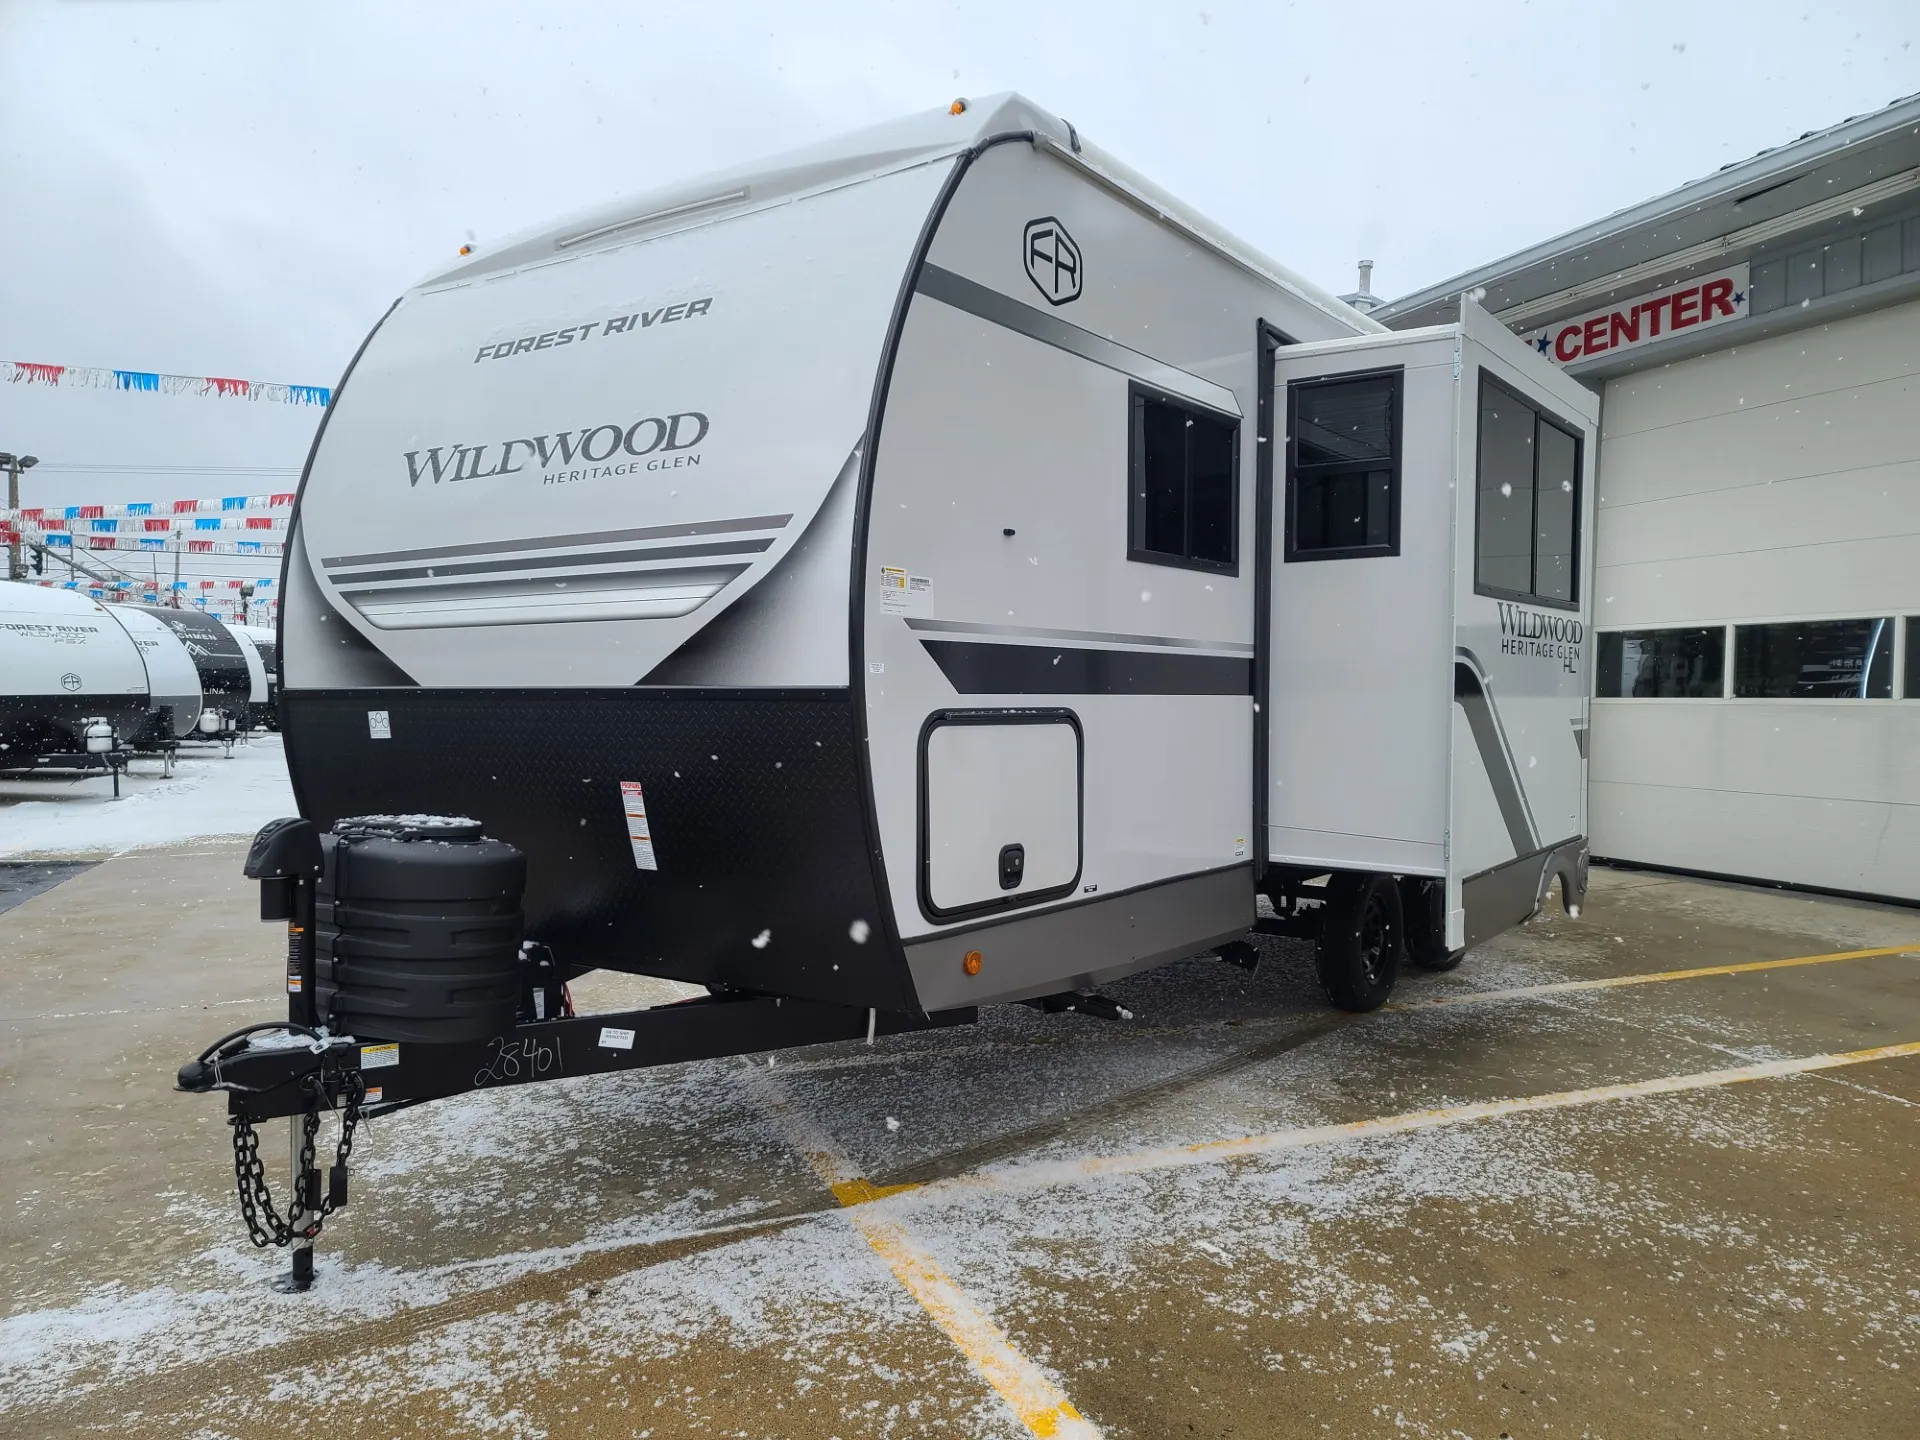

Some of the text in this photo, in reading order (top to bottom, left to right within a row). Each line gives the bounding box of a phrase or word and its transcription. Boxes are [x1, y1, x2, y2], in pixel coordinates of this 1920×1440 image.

[474, 297, 713, 364] FOREST RIVER
[1555, 277, 1736, 362] CENTER
[403, 411, 710, 488] WILDWOOD
[543, 454, 702, 485] HERITAGE GLEN
[0, 623, 99, 633] FOREST RIVER
[1497, 602, 1583, 644] WILDWOOD
[1501, 638, 1580, 660] HERITAGE GLEN
[203, 687, 225, 695] LINA
[474, 1036, 564, 1087] 28401
